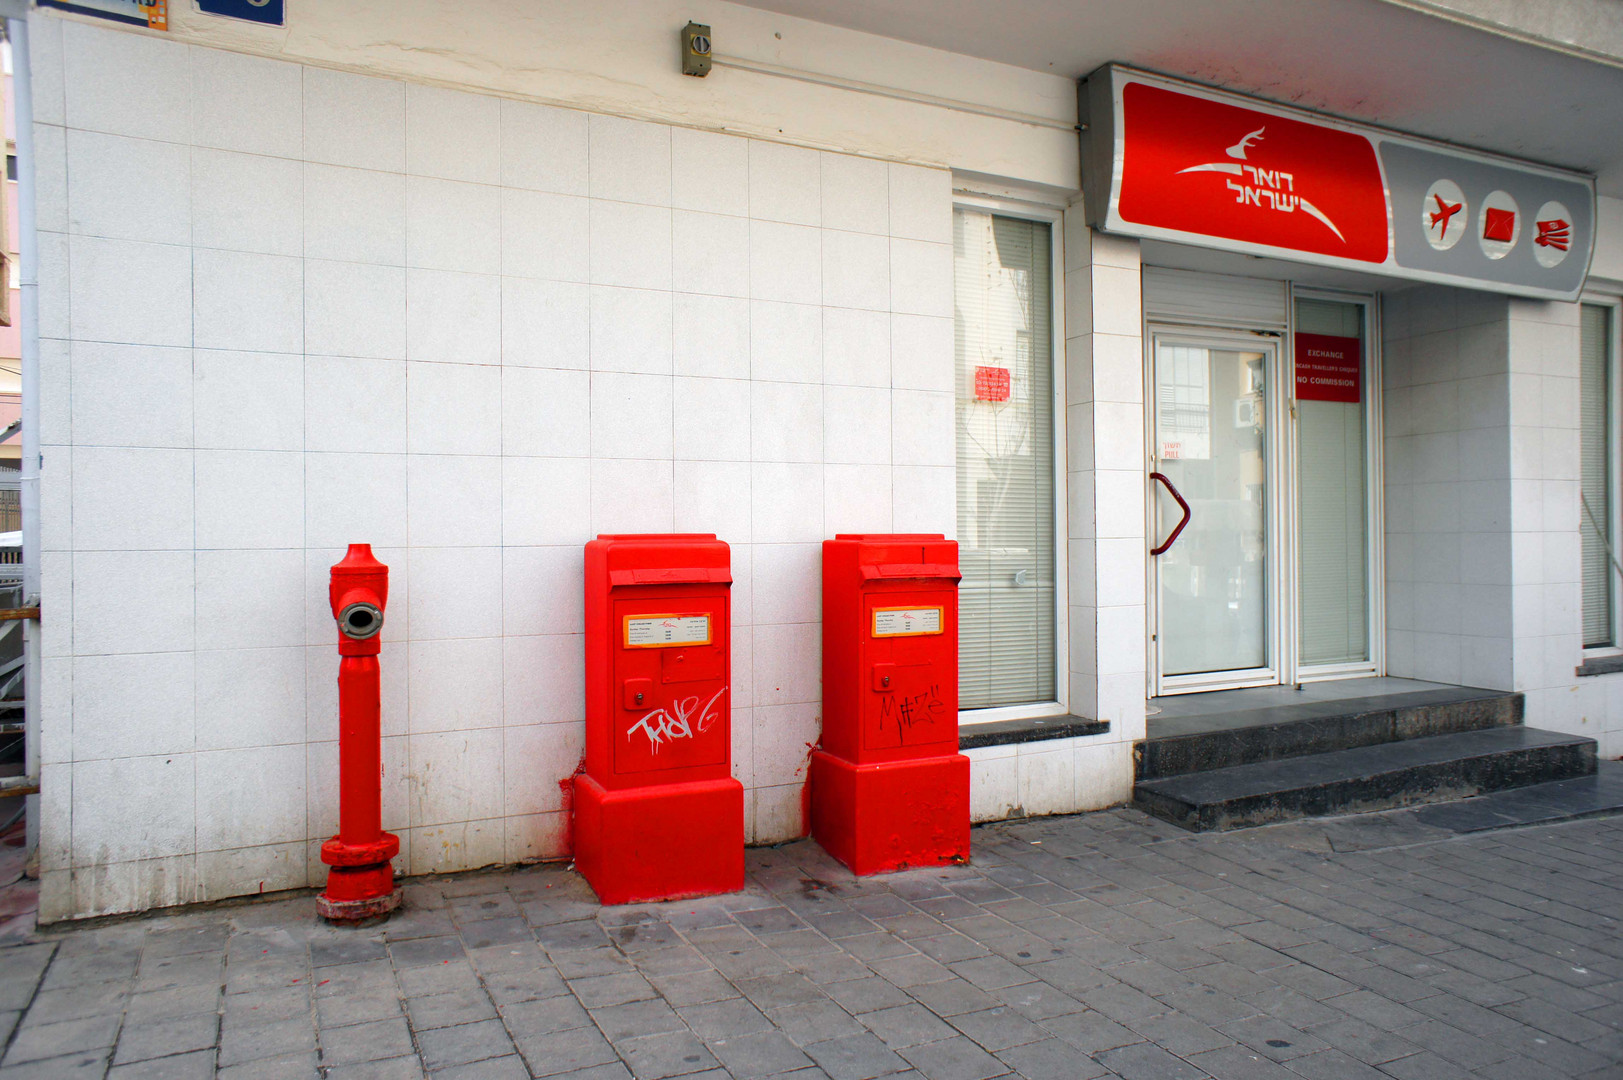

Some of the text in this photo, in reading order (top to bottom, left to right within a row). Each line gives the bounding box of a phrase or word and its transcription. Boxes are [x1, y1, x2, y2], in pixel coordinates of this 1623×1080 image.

[1242, 164, 1294, 192] דואר
[1226, 178, 1300, 213] ישראל
[1307, 349, 1344, 359] EXCHANGE
[1296, 376, 1355, 387] NO COMMISSION
[1164, 450, 1180, 458] PULL
